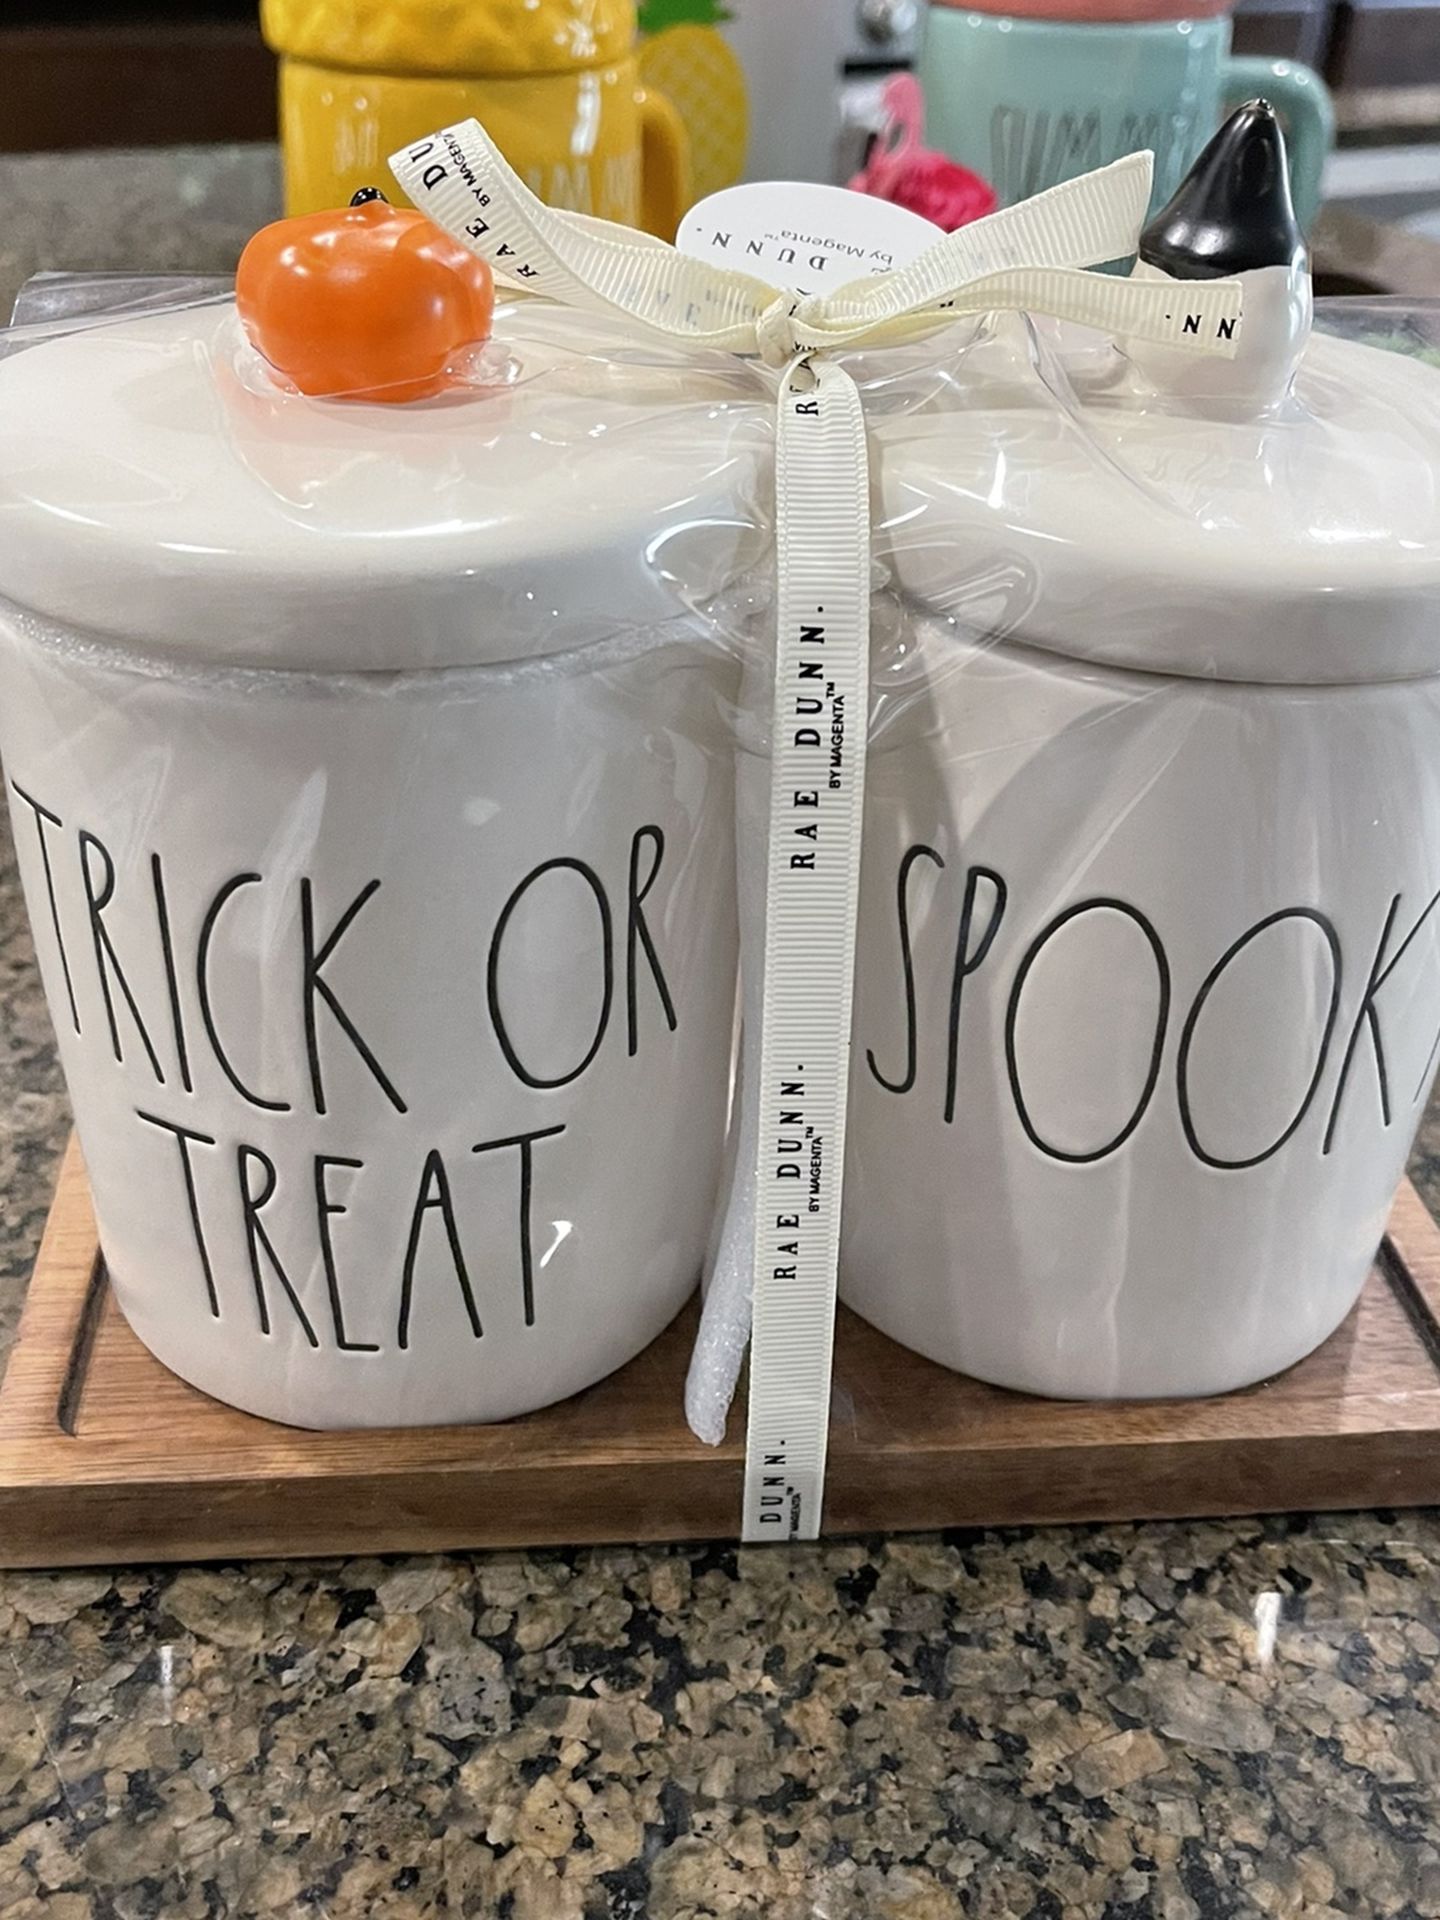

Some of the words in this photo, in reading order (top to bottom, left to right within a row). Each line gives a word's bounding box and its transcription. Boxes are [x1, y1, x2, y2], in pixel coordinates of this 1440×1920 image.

[472, 187, 491, 207] BY
[466, 217, 540, 278] RAE
[868, 252, 894, 265] by
[795, 606, 825, 747] DUNN.
[829, 770, 842, 789] BY
[790, 790, 819, 870] RAE
[12, 780, 408, 1115] TRICK
[486, 825, 678, 1090] OR
[866, 844, 1440, 1170] SPOOK
[776, 1064, 805, 1179] DUNN.
[135, 1108, 567, 1351] TREAT
[808, 1197, 820, 1212] BY
[773, 1214, 800, 1280] RAE
[759, 1440, 786, 1523] DUNN.
